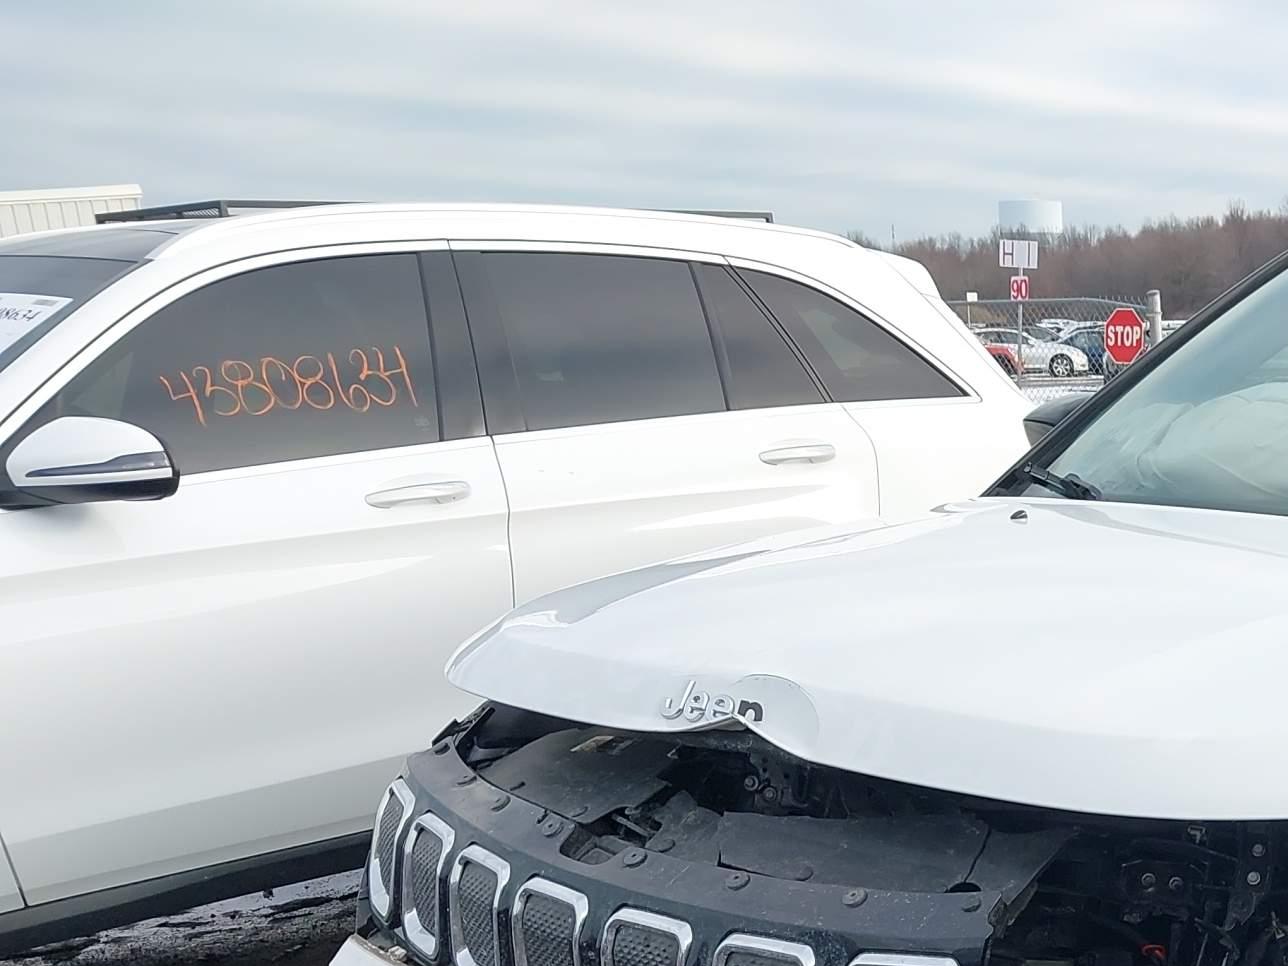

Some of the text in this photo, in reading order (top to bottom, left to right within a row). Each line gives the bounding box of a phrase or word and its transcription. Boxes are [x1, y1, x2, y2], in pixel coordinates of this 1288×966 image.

[1003, 241, 1014, 265] H
[1012, 280, 1027, 299] 90
[1108, 325, 1141, 347] STOP
[159, 346, 418, 427] 43808634
